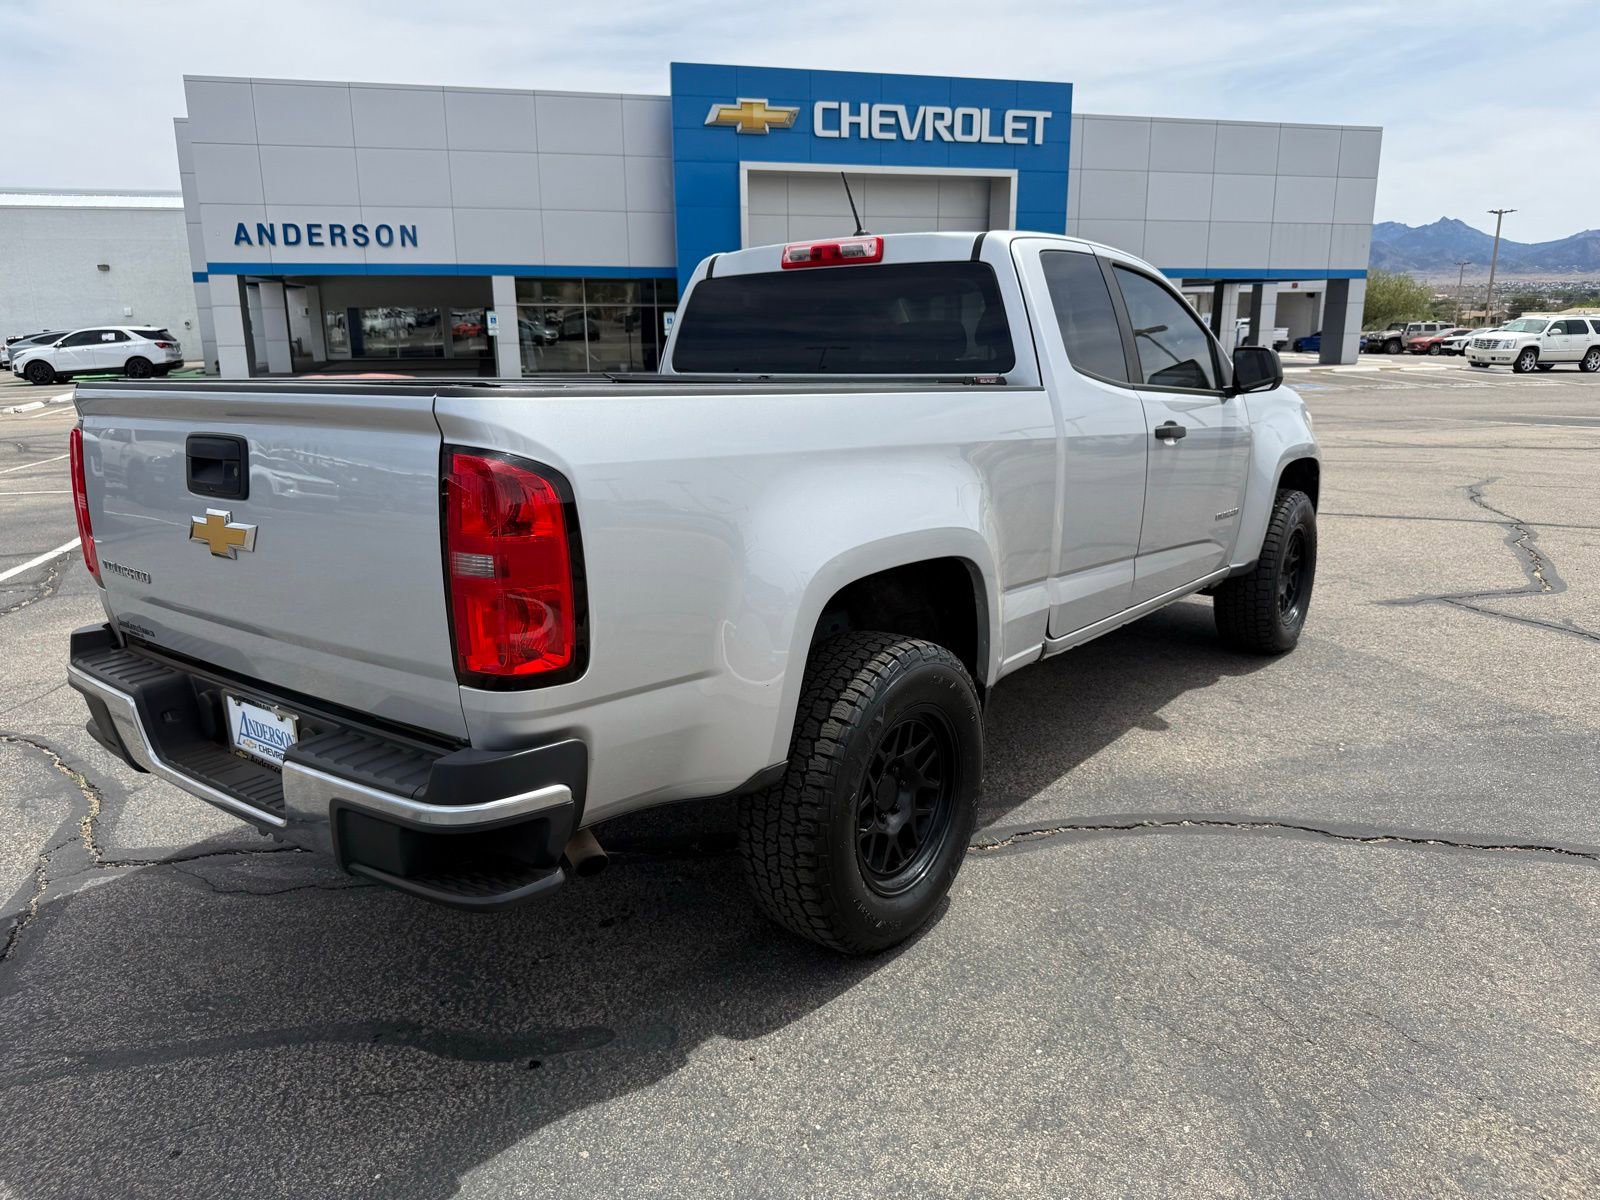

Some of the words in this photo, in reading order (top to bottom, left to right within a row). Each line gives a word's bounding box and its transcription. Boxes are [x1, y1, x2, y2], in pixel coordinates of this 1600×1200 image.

[813, 100, 1053, 145] CHEVROLET
[234, 222, 418, 247] ANDERSON
[236, 711, 295, 747] ANDERSON
